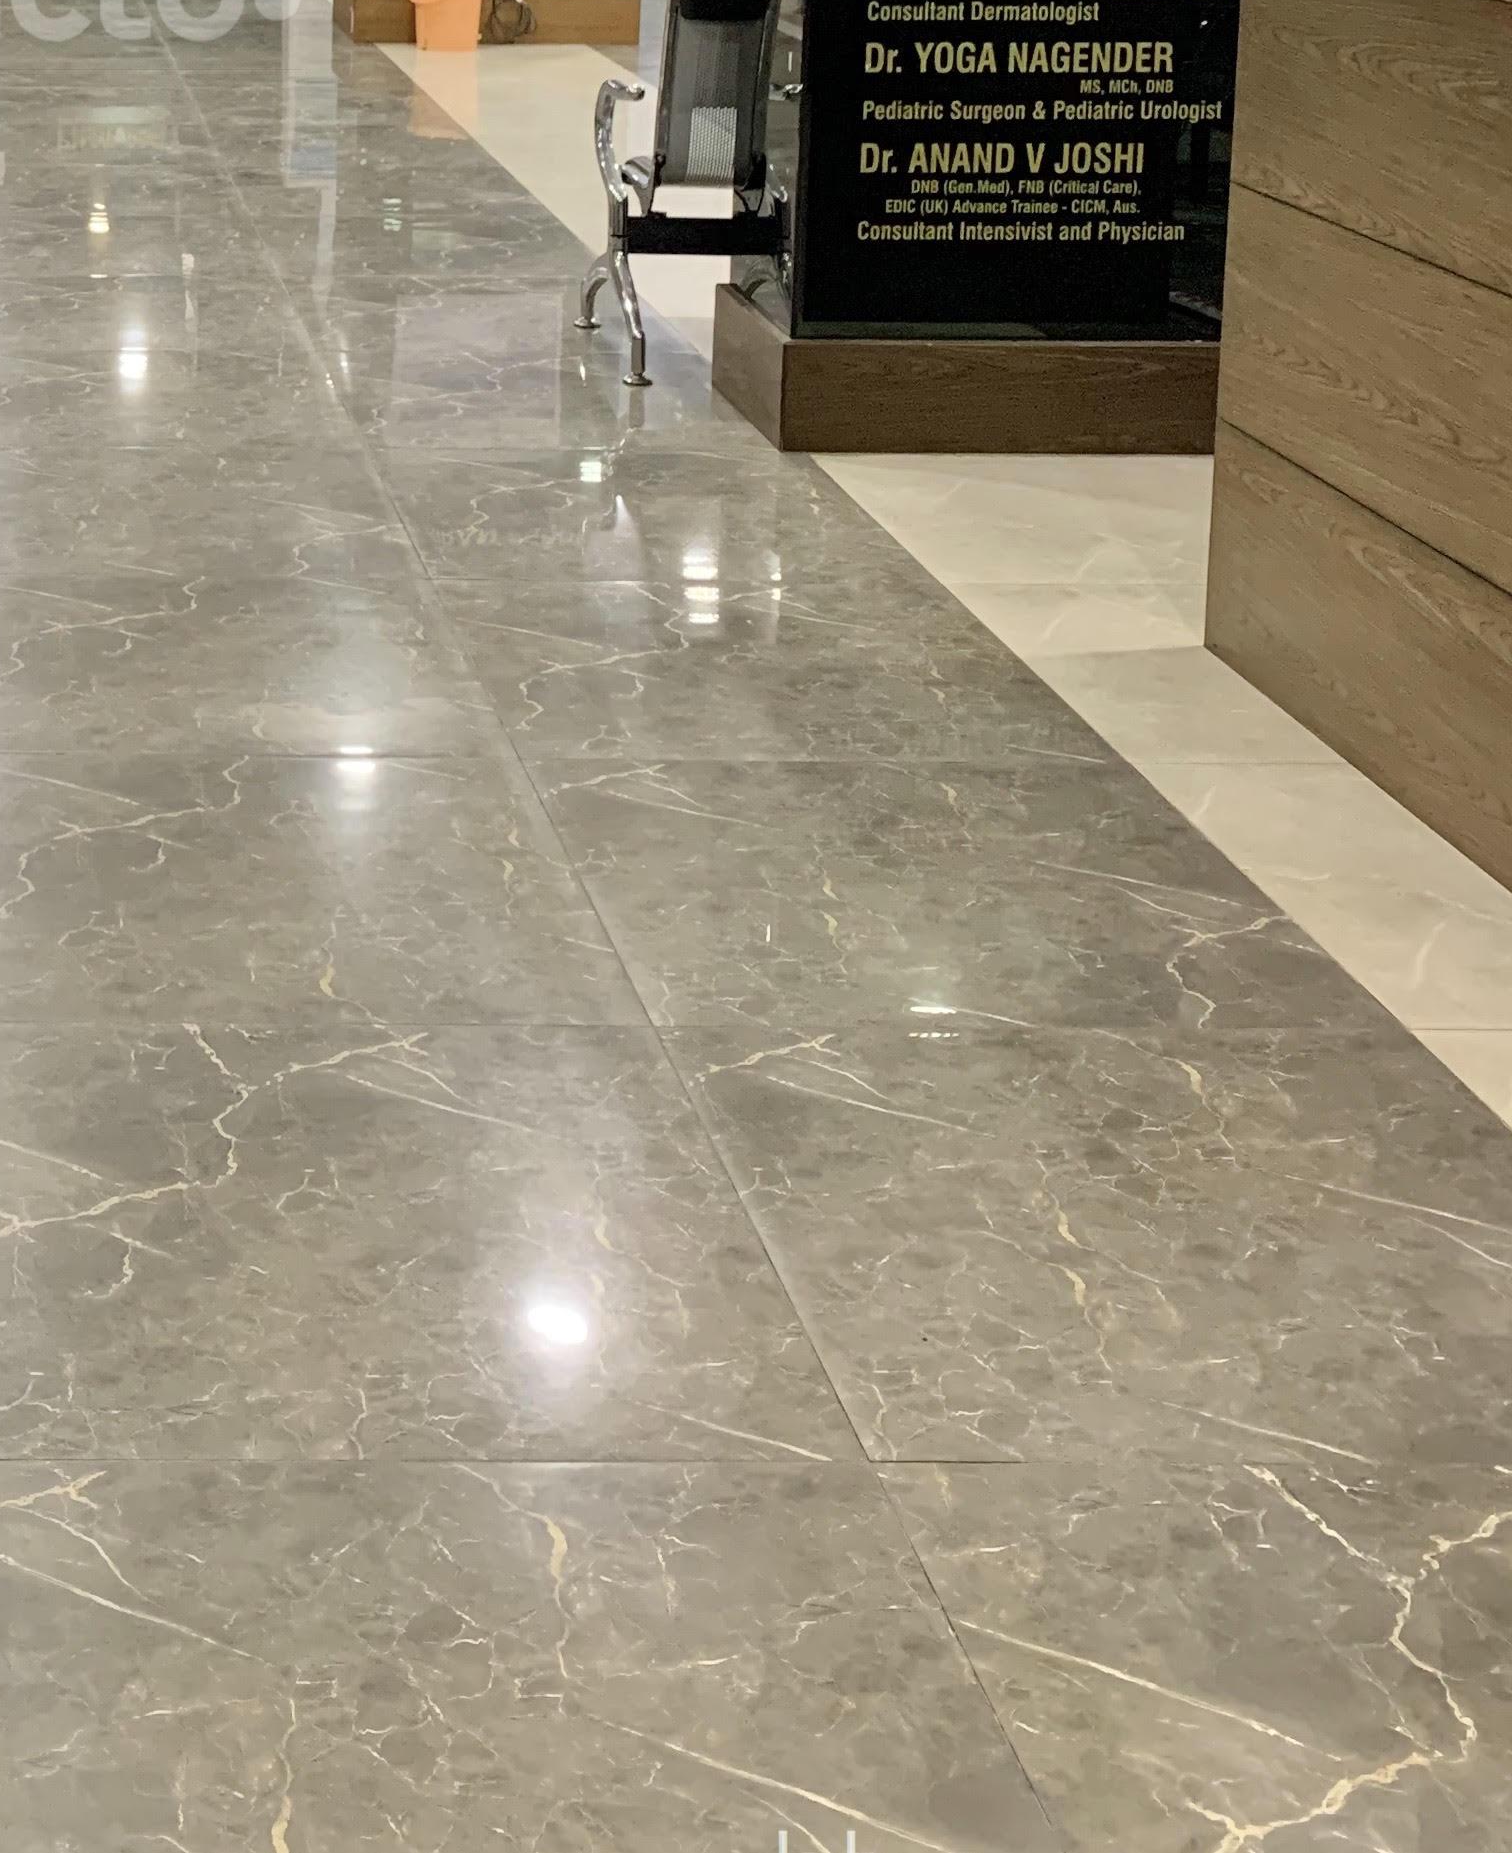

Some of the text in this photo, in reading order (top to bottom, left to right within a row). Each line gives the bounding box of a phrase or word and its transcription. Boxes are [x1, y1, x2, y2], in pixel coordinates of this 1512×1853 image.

[867, 0, 1100, 26] Consultant Dermatologist
[864, 41, 1174, 74] Dr. YOGA NAGENDER
[1080, 80, 1105, 95] MS,
[1145, 80, 1174, 94] DNB
[862, 100, 1222, 124] Pediatric Surgeon & Pediatric Urologist
[859, 142, 1144, 174] Dr. ANAND V JOSHI
[911, 180, 939, 194] DNB
[1018, 180, 1044, 194] FNB
[1049, 180, 1100, 196] (Critical
[885, 199, 916, 214] EDIC
[920, 199, 949, 215] (UK)
[952, 199, 1007, 214] Advance
[1011, 200, 1058, 213] Trainee
[1113, 200, 1140, 213] Aus.
[857, 220, 1185, 245] Consultant Intensivist and Physician
